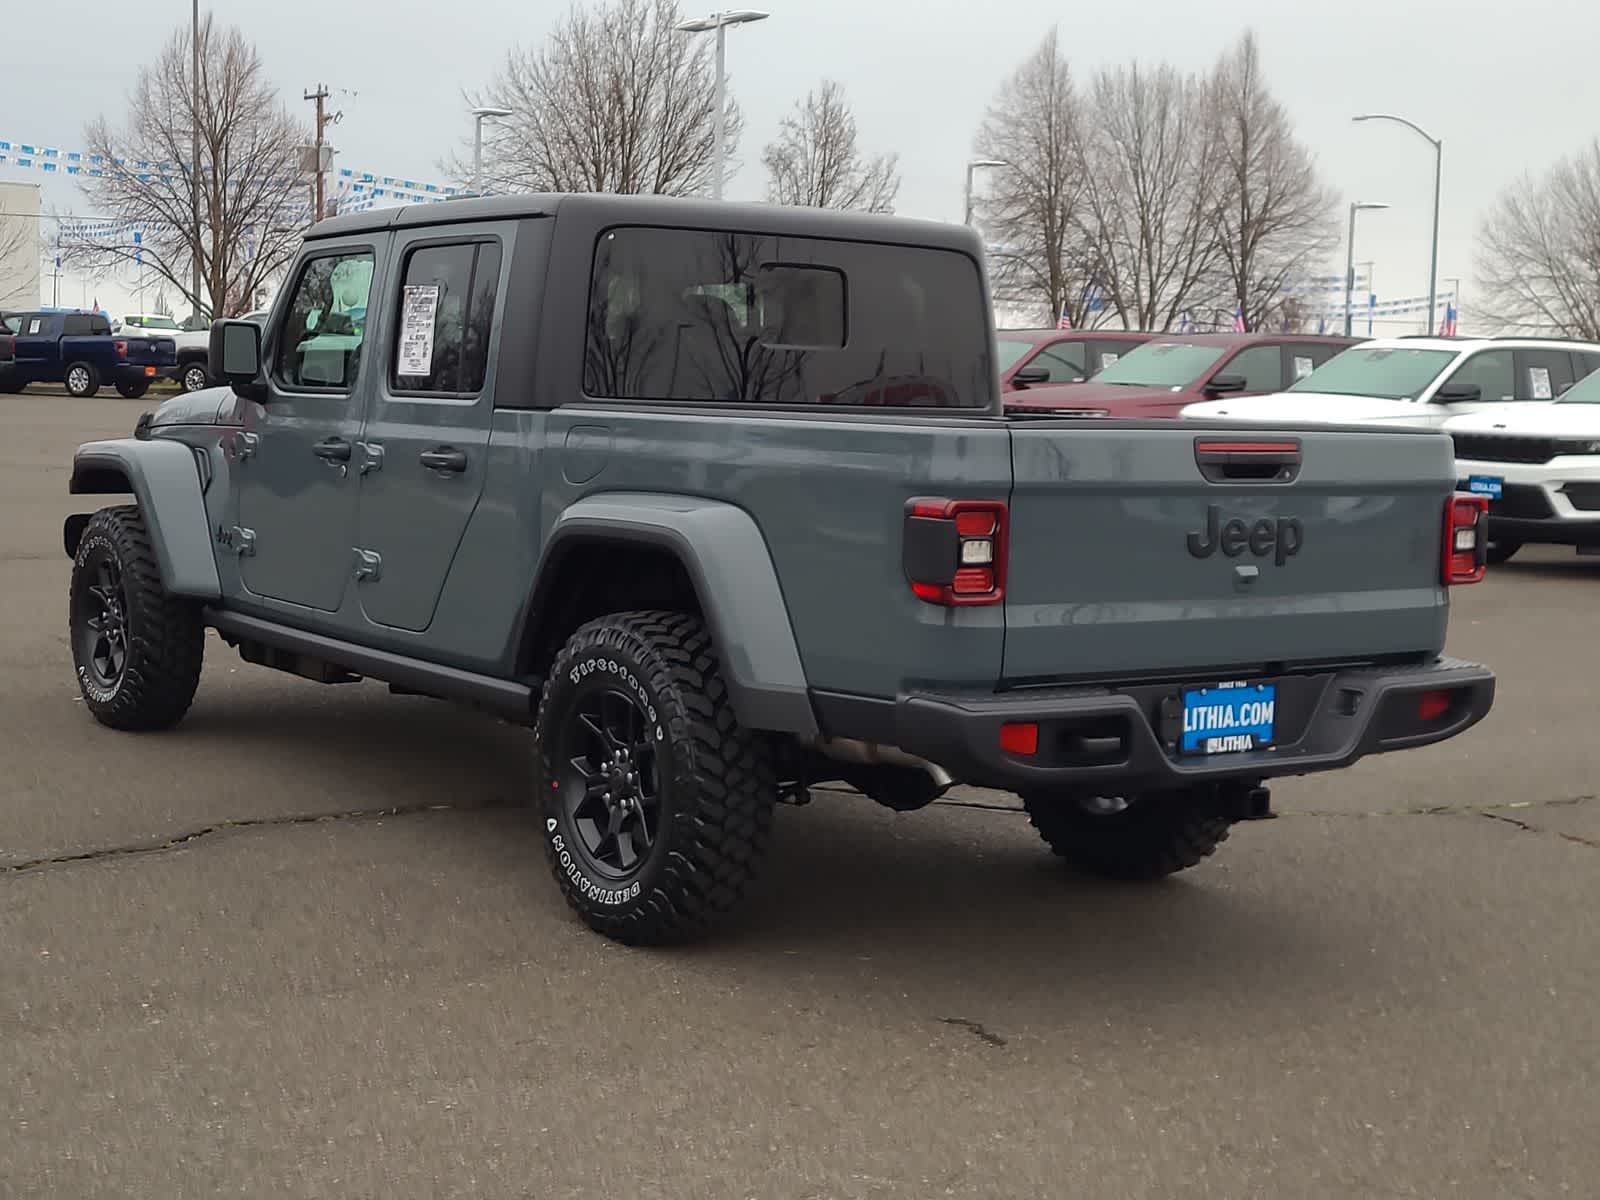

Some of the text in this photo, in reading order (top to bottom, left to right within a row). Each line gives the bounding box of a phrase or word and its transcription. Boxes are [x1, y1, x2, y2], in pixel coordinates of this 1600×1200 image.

[1186, 503, 1304, 568] Jeep
[569, 658, 657, 723] Firestone
[1183, 701, 1275, 732] LITHIA.COM
[1217, 734, 1253, 753] LITHIA
[551, 834, 641, 905] DESTINATION
